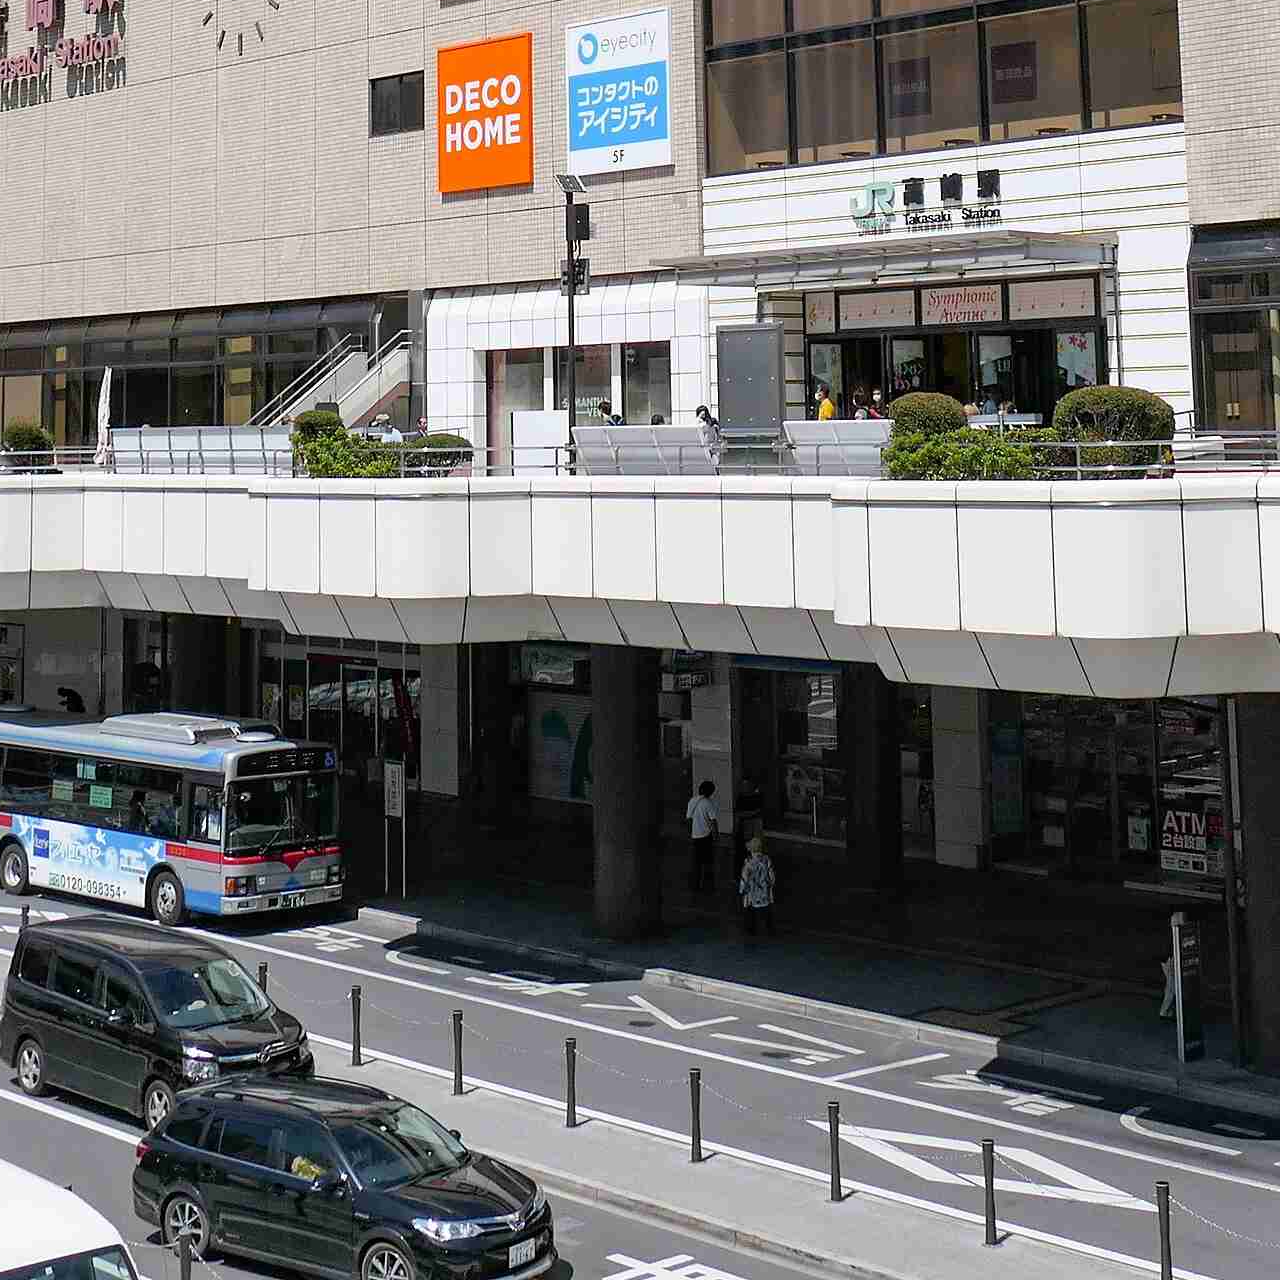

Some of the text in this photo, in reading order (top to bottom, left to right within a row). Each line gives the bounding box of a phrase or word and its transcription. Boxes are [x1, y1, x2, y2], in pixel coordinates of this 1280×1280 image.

[601, 28, 657, 57] eyecity
[445, 75, 521, 114] DECO
[577, 76, 659, 107] コンタクトの
[445, 114, 520, 152] HOME
[577, 102, 658, 136] アイシティ
[850, 182, 895, 217] JR
[903, 210, 951, 225] Takasaki
[961, 206, 1000, 220] Station
[1162, 810, 1206, 835] ATM
